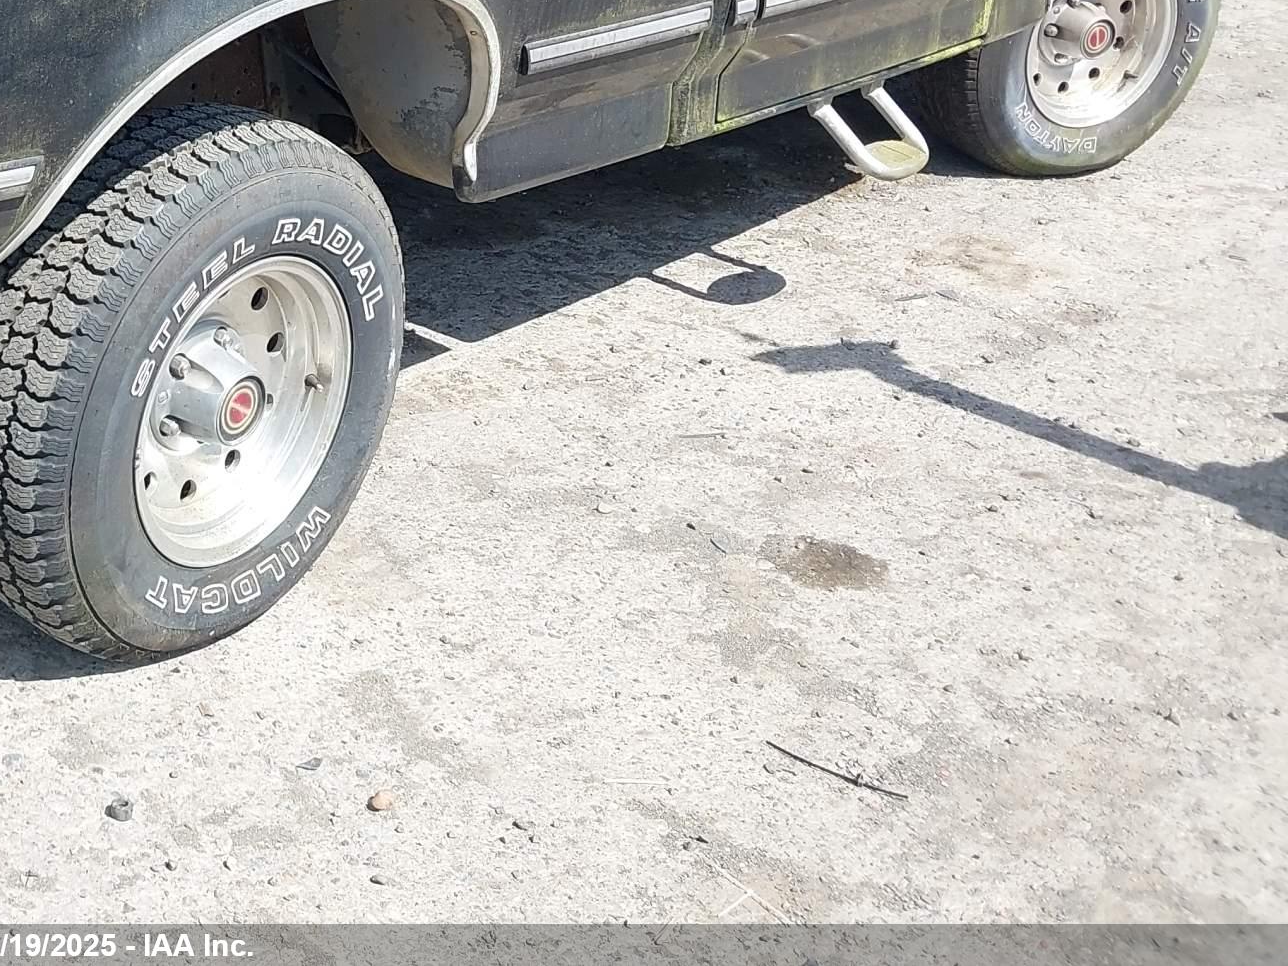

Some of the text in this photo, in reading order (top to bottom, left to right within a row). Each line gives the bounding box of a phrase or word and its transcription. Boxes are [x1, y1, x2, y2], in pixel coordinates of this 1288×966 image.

[1015, 101, 1097, 154] DAYTON
[130, 217, 387, 397] STEEL RADIAL
[145, 505, 332, 615] WILDCAT
